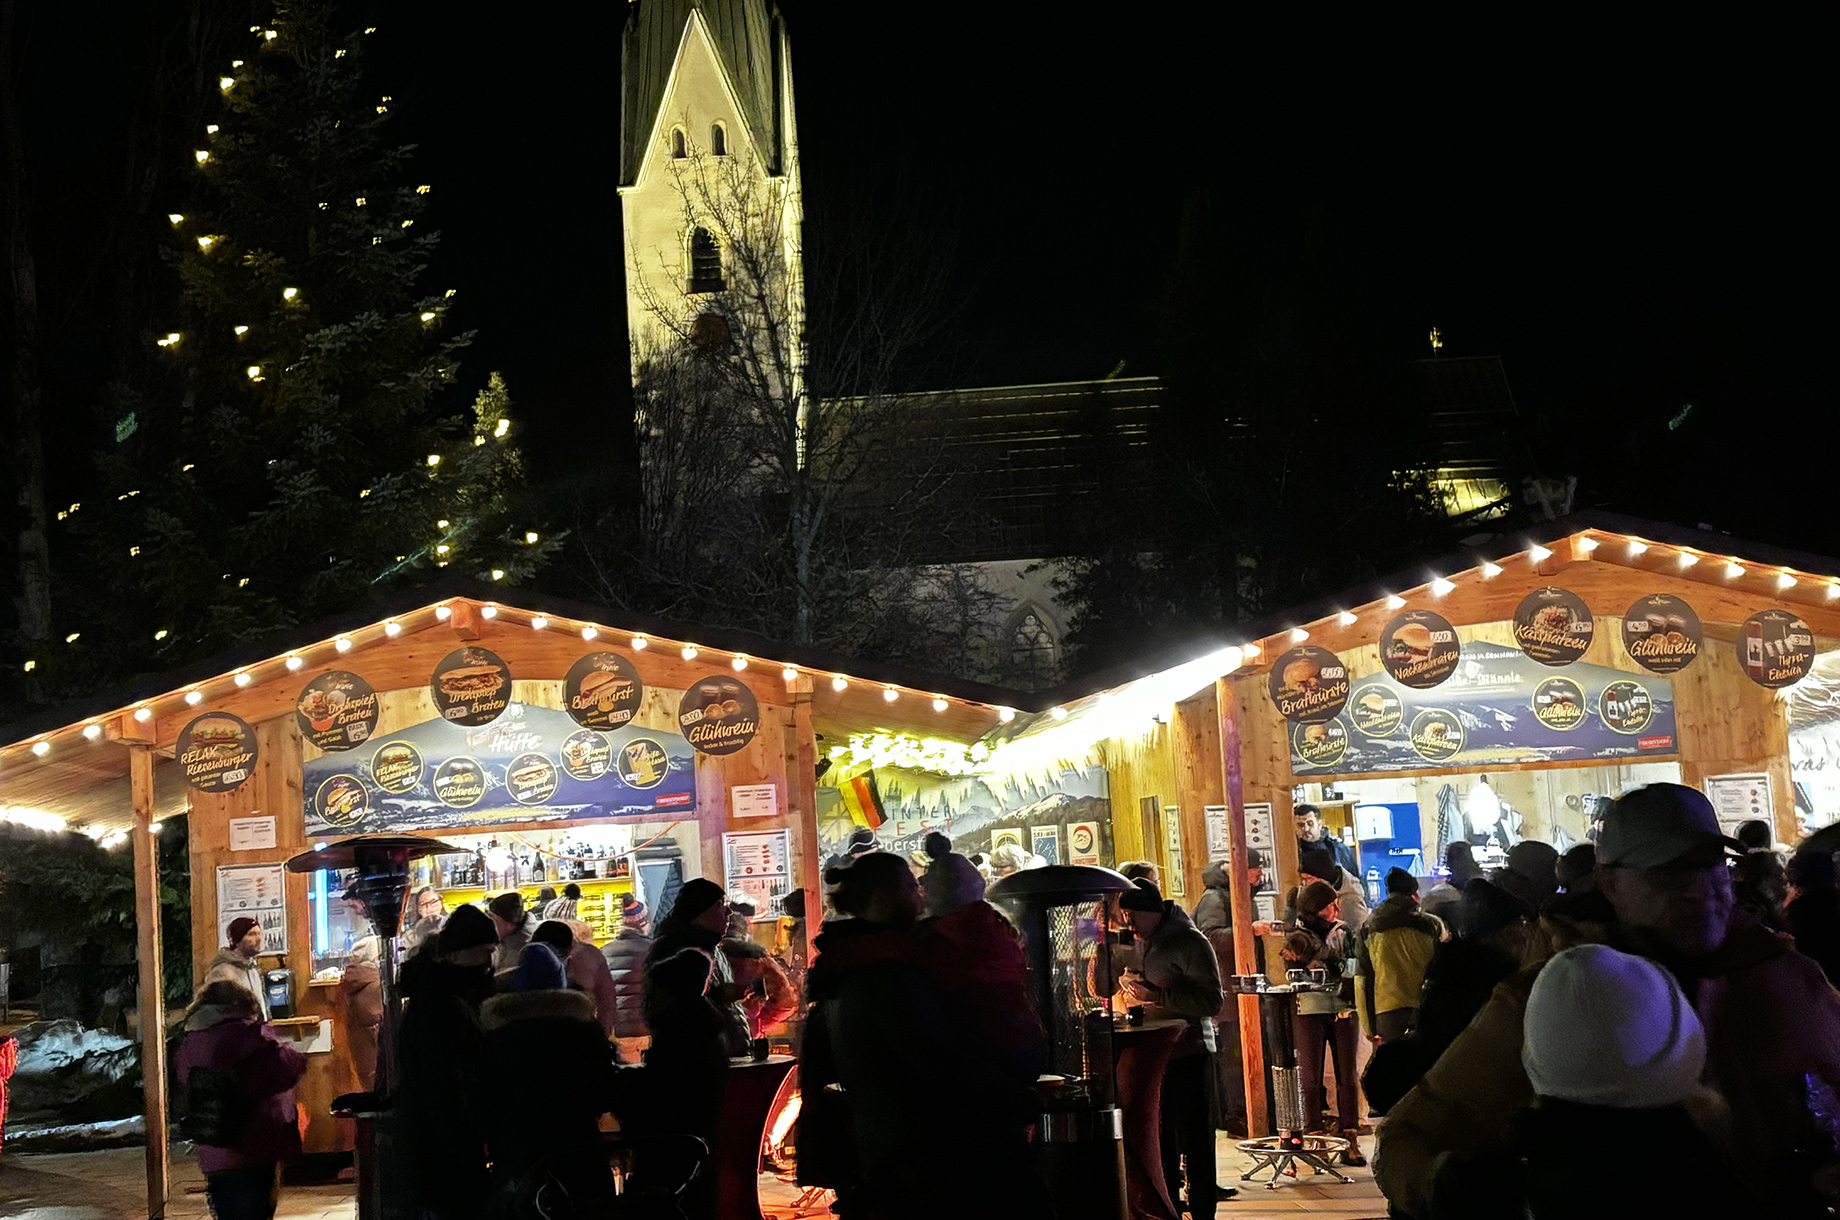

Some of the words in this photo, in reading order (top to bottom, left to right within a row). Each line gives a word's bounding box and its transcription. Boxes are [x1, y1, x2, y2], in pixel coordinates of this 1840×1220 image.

[1630, 637, 1697, 656] Glühwein
[1394, 650, 1459, 681] Nackenbraten
[328, 692, 376, 715] Drehspieß
[471, 699, 506, 714] Braten
[572, 685, 634, 710] Bratwurst
[337, 709, 373, 725] Braten
[689, 718, 755, 743] Glühwein
[488, 732, 544, 753] Hütte
[181, 746, 218, 764] RELAX
[187, 752, 254, 776] Riesenburger
[892, 804, 953, 820] INTER
